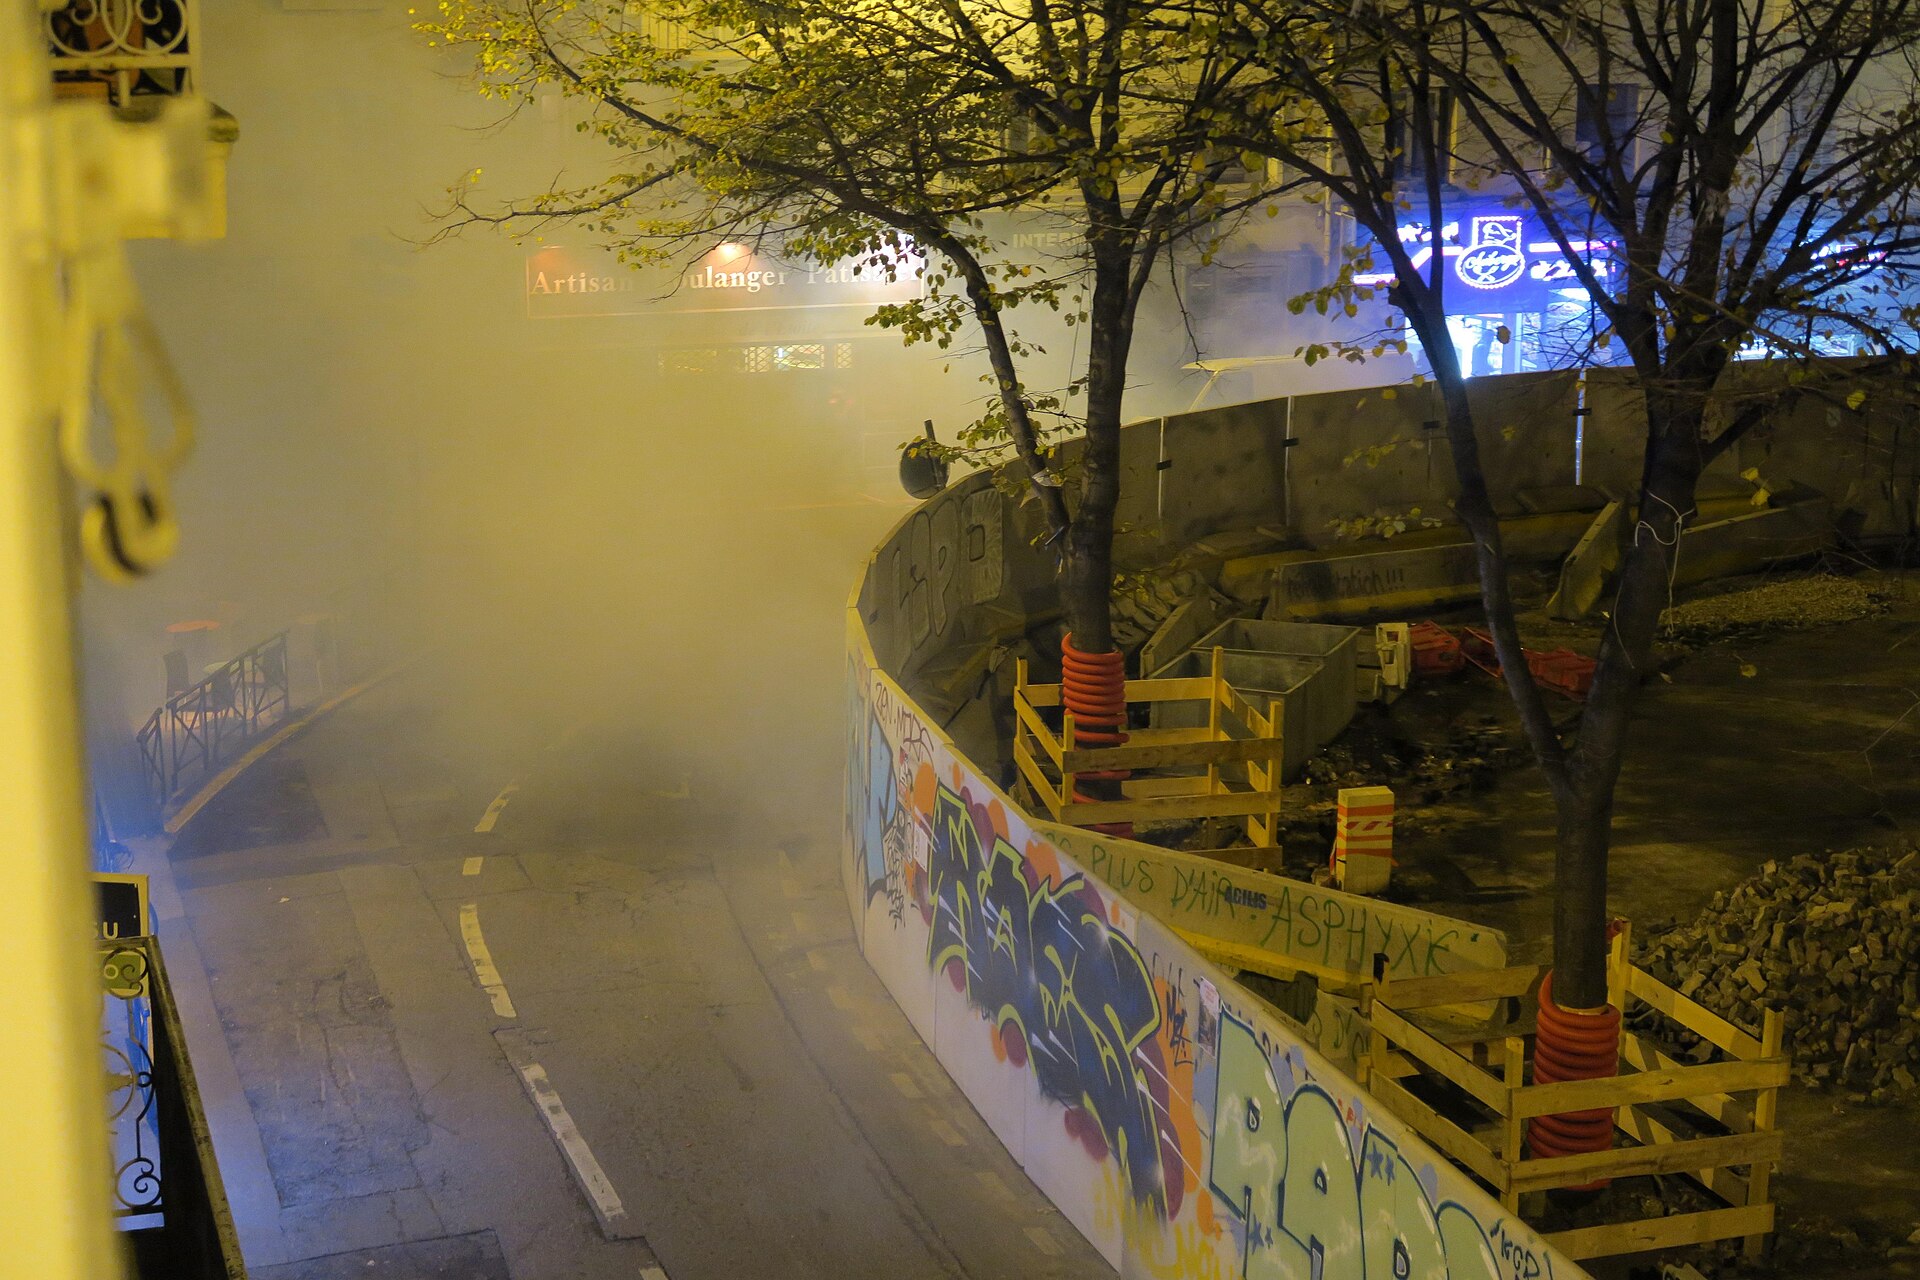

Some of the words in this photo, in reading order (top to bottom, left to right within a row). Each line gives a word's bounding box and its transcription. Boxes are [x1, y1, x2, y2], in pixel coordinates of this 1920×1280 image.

[529, 271, 633, 295] Artisan
[676, 265, 787, 294] oulanger
[1091, 844, 1155, 894] PLUS
